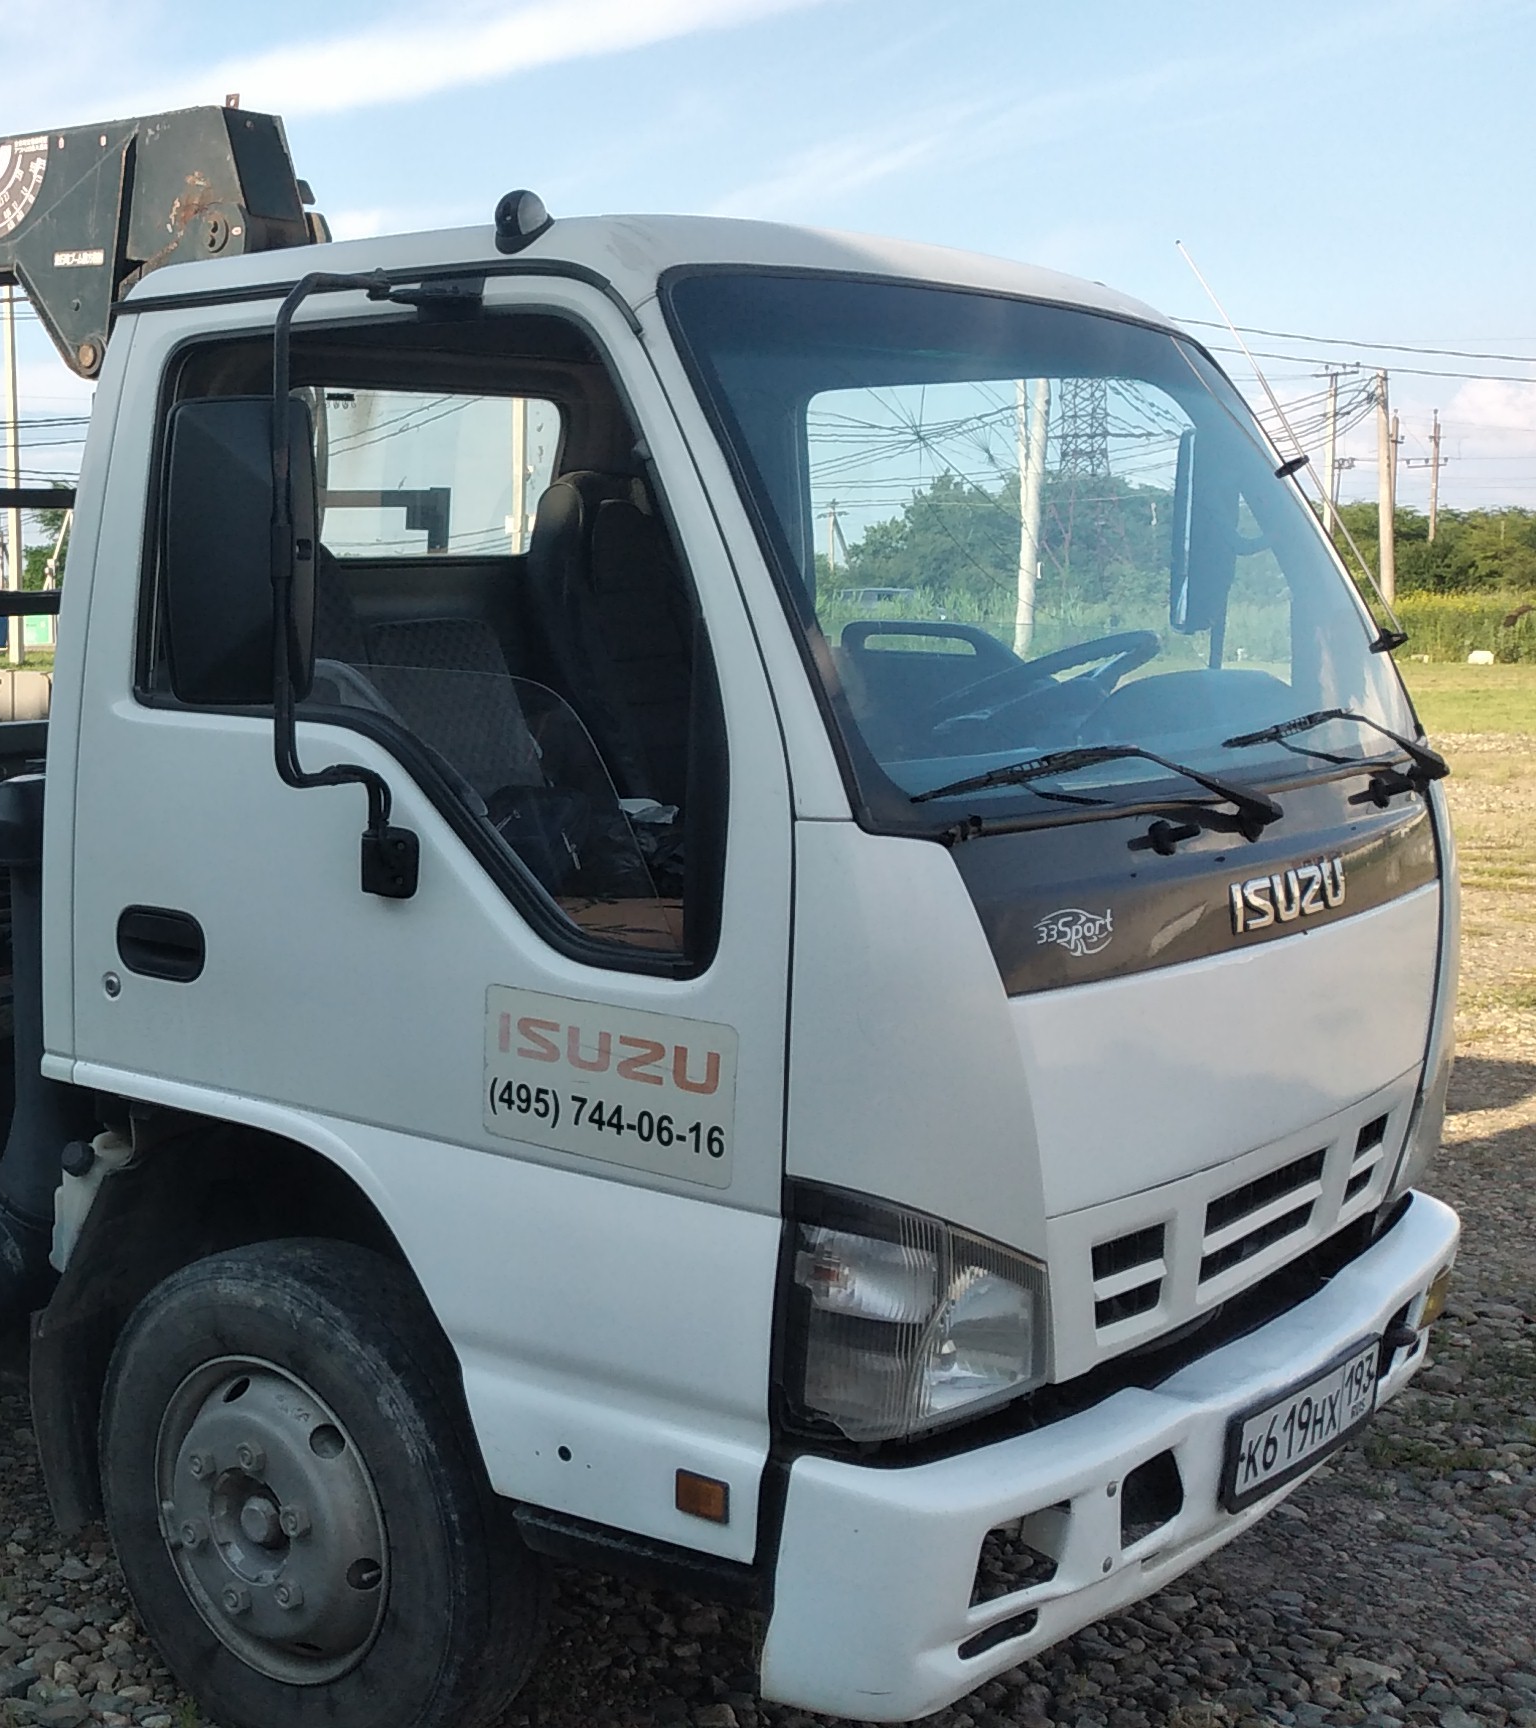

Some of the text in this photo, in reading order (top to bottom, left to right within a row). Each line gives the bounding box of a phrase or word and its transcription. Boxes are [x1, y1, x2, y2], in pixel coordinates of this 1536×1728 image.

[1229, 857, 1346, 935] ISUZU
[498, 1012, 722, 1096] ISUZU
[489, 1077, 726, 1159] (495) 744-06-16
